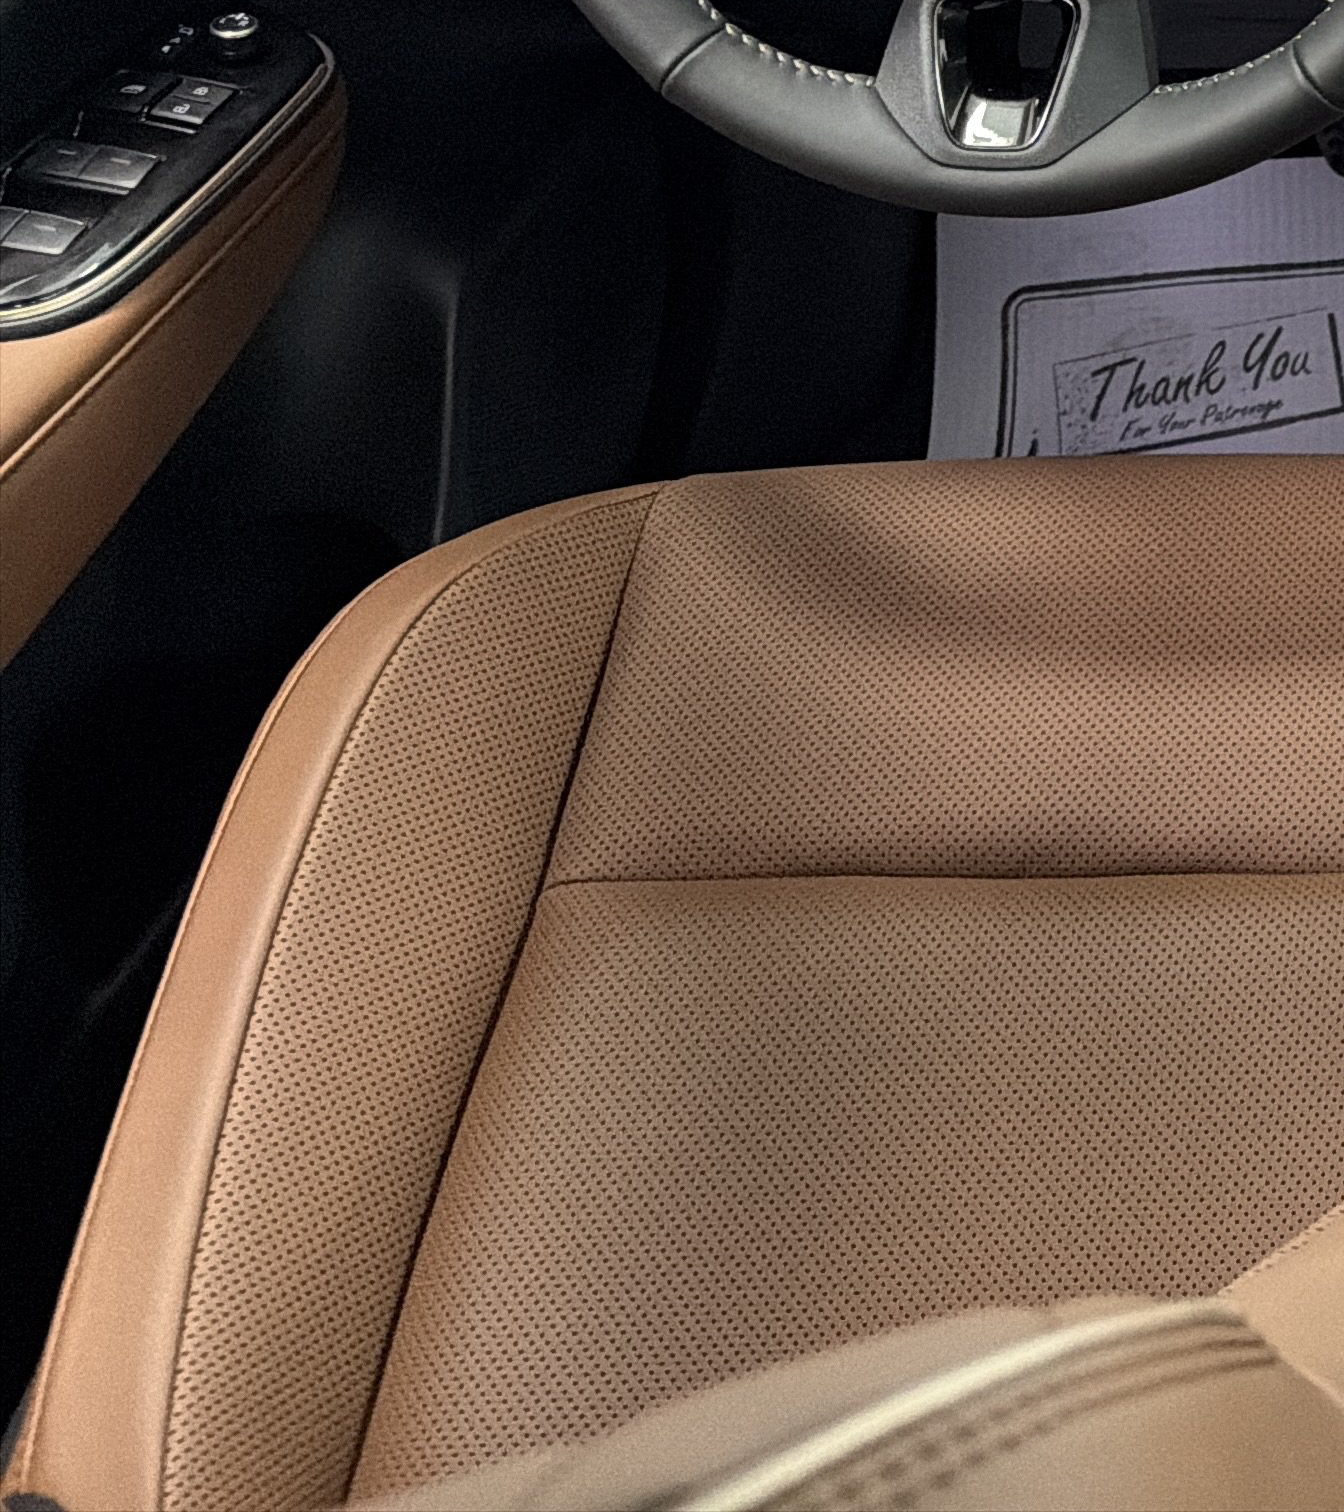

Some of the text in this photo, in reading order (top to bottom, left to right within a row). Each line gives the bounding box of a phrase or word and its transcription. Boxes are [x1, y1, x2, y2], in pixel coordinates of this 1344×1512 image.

[1091, 326, 1312, 422] Thank You
[1120, 399, 1283, 442] For Your Patronage
